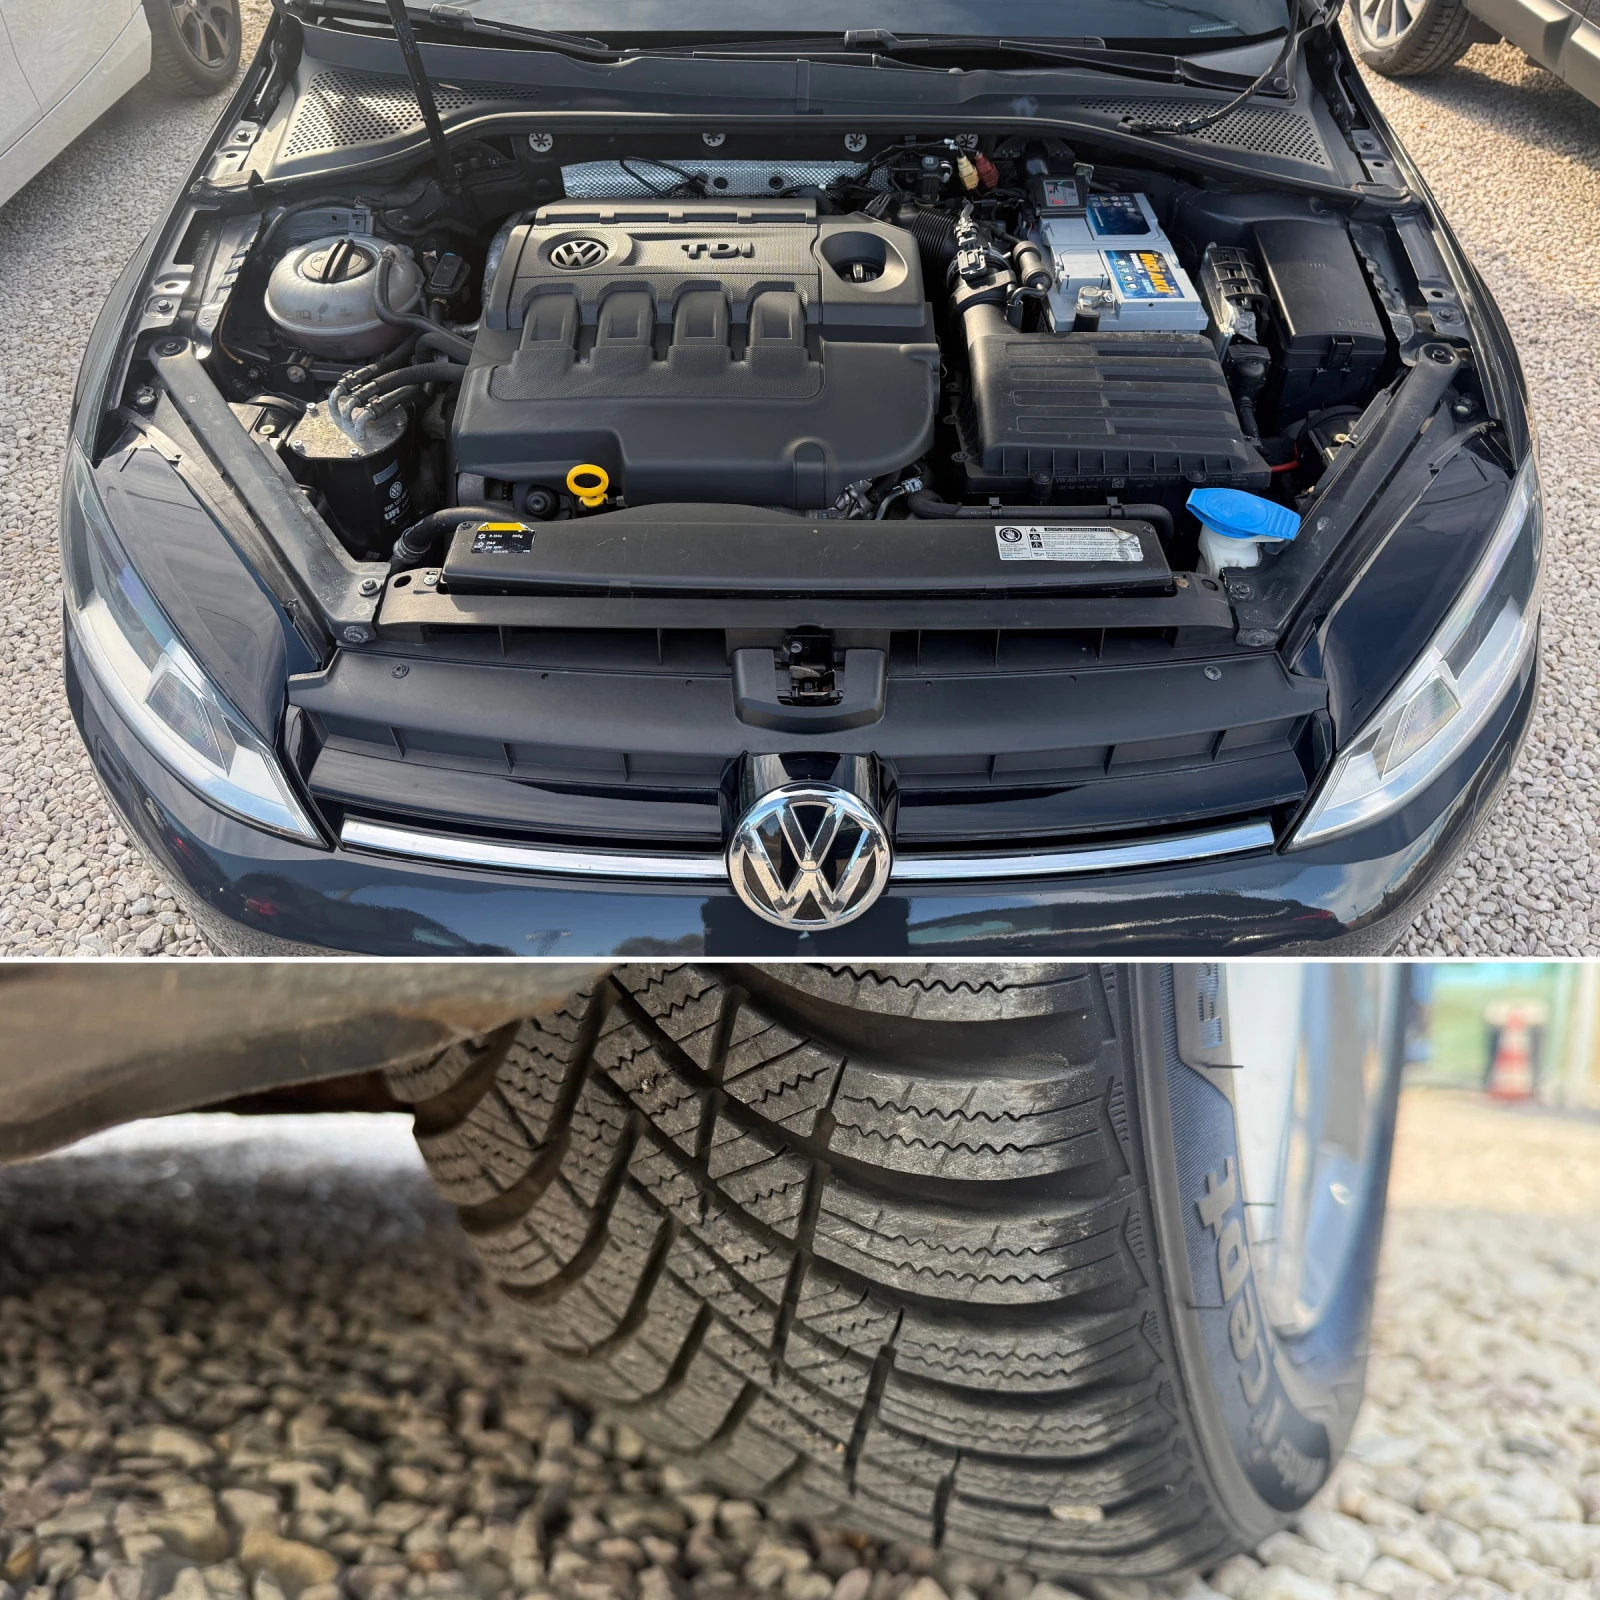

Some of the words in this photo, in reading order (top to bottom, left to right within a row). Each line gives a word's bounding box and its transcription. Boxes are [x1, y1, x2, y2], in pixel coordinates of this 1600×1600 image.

[681, 241, 754, 259] TDI
[384, 505, 400, 520] UFI
[726, 781, 893, 931] VW
